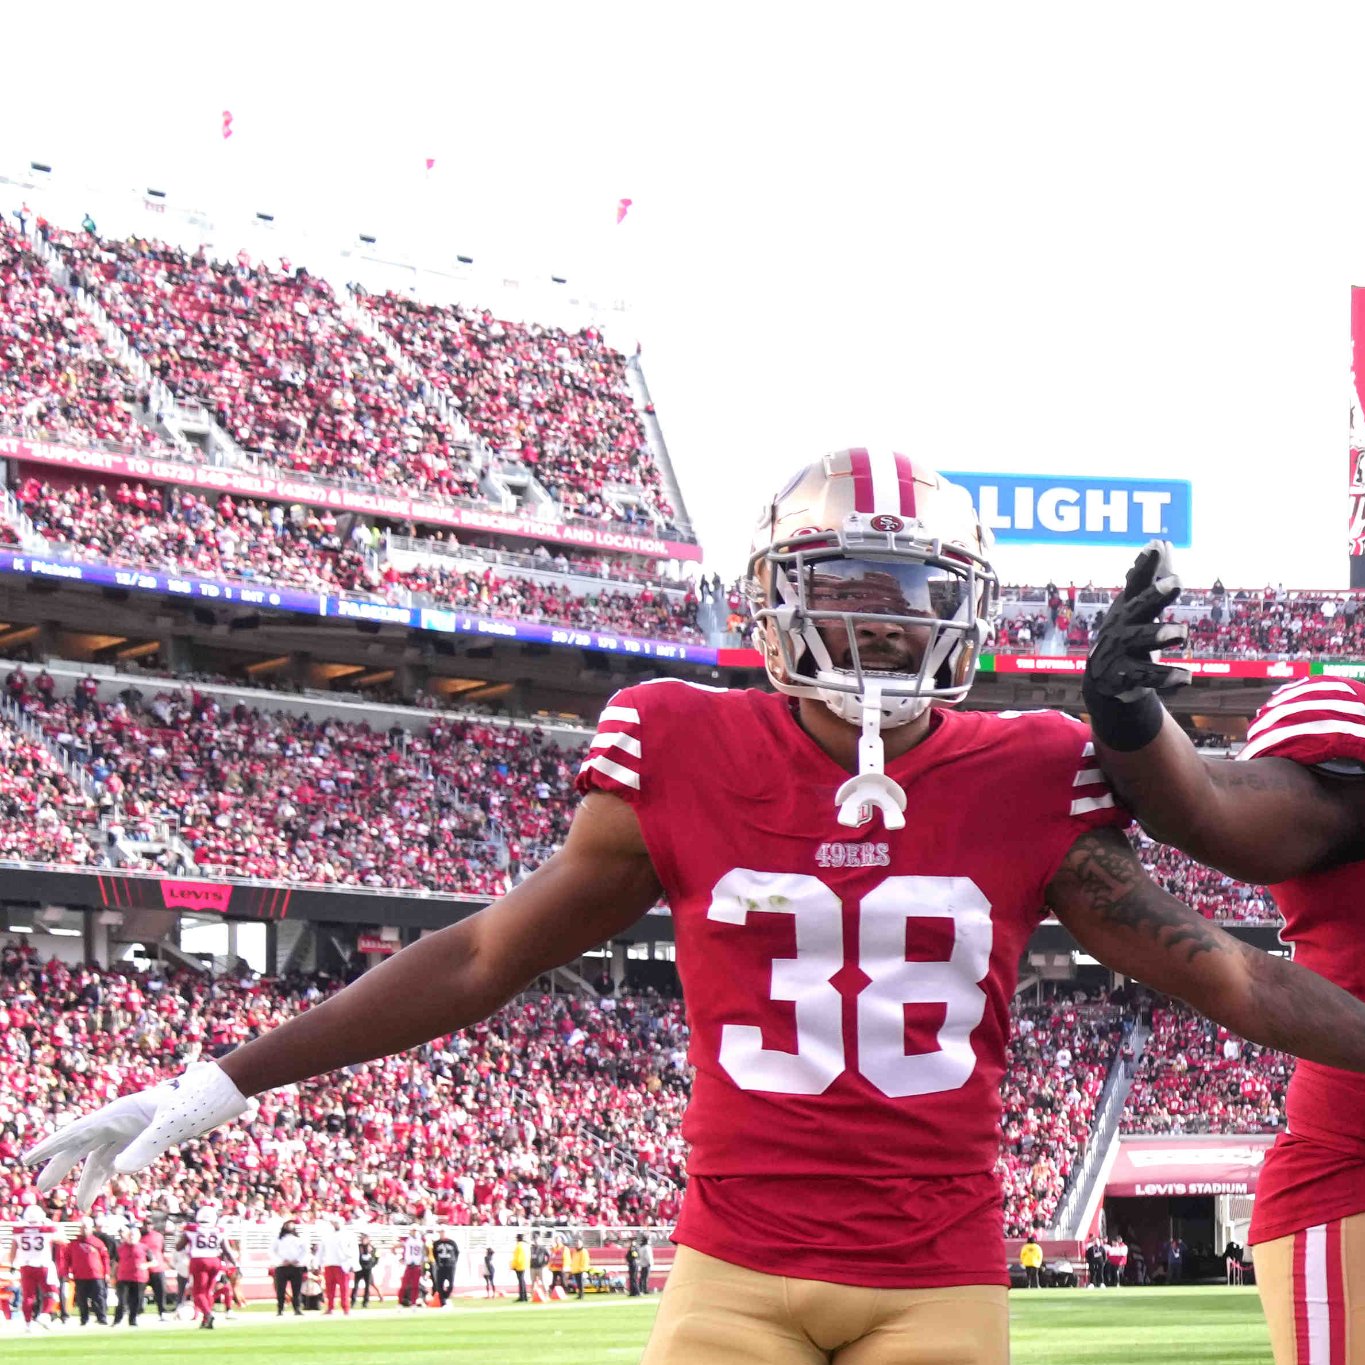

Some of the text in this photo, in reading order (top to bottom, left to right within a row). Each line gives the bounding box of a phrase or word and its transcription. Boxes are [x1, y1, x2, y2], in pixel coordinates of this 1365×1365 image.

[126, 457, 150, 474] TO
[563, 528, 594, 544] AND
[596, 532, 669, 554] LOCATION.
[979, 486, 1171, 534] LIGHT
[815, 842, 890, 867] 49ERS
[706, 867, 992, 1098] 38
[1188, 1182, 1248, 1195] STADIUM
[20, 1236, 45, 1252] 53
